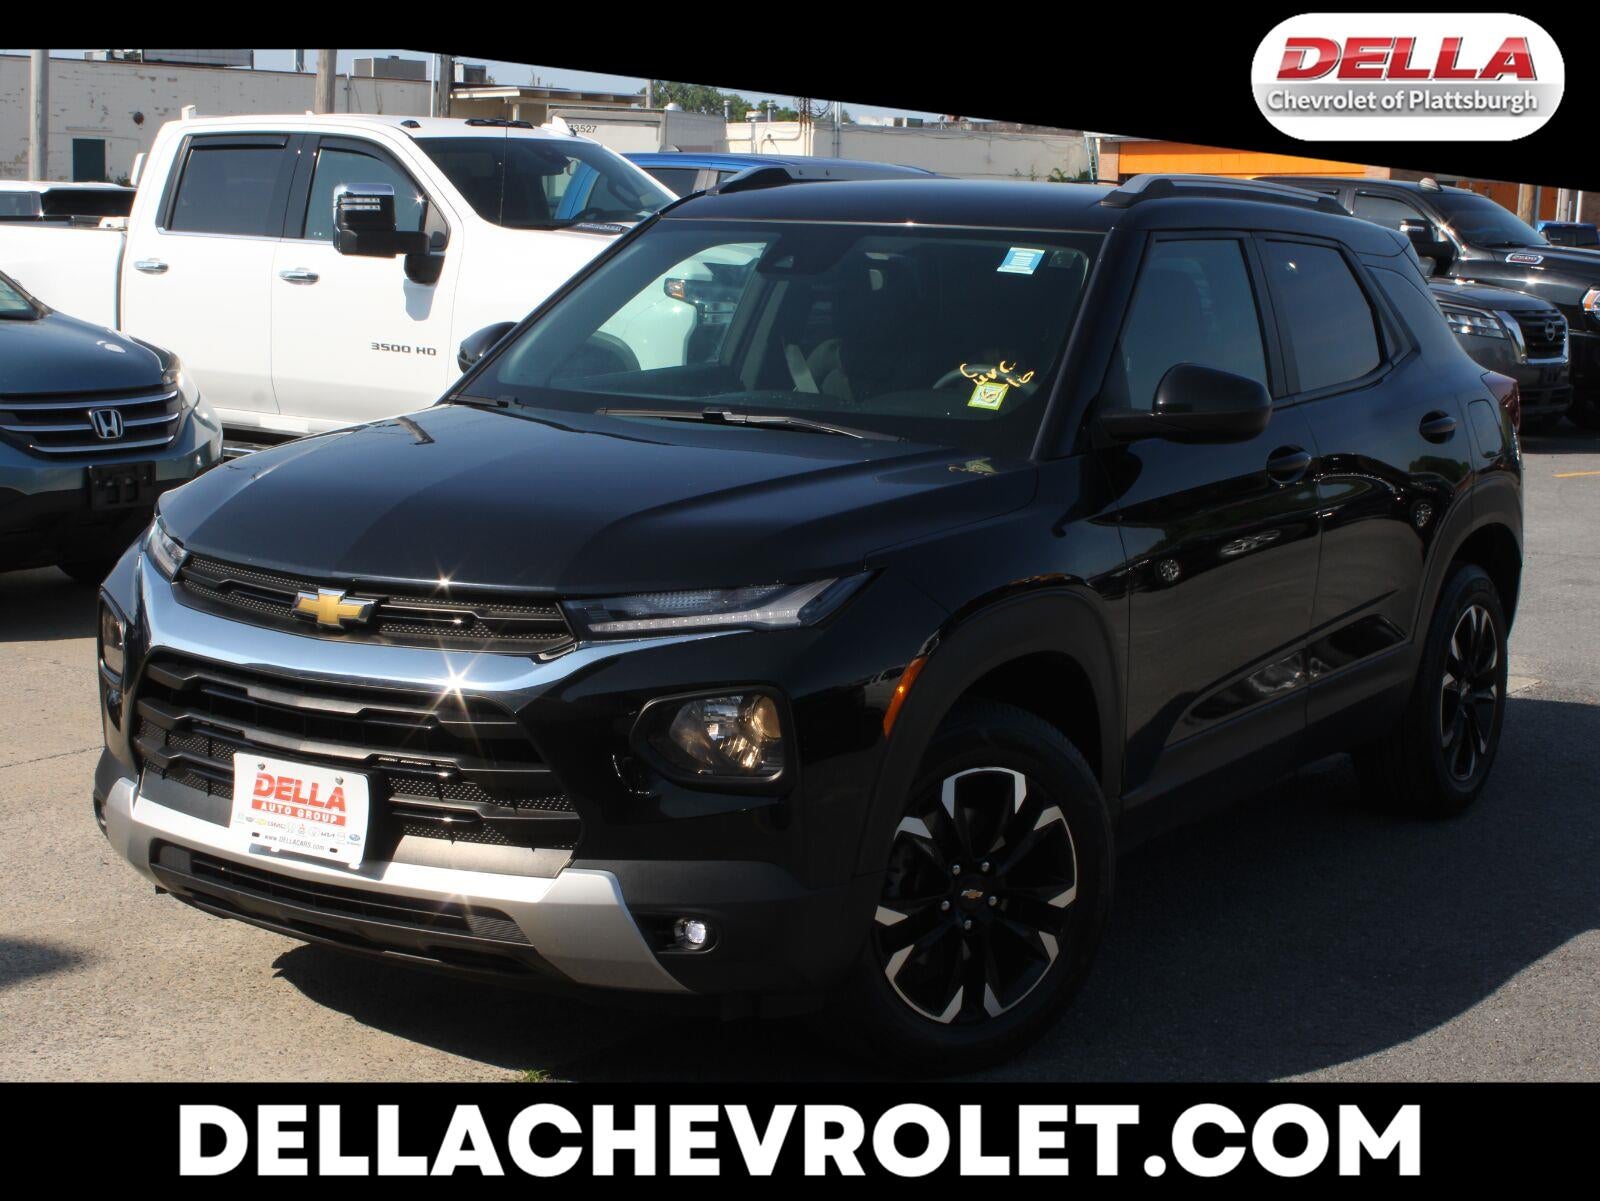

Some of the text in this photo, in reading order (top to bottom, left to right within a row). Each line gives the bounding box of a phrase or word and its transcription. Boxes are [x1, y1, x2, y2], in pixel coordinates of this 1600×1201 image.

[370, 342, 437, 356] 3500 HD
[253, 772, 346, 812] DELLA
[260, 801, 338, 824] AUTO GROUP
